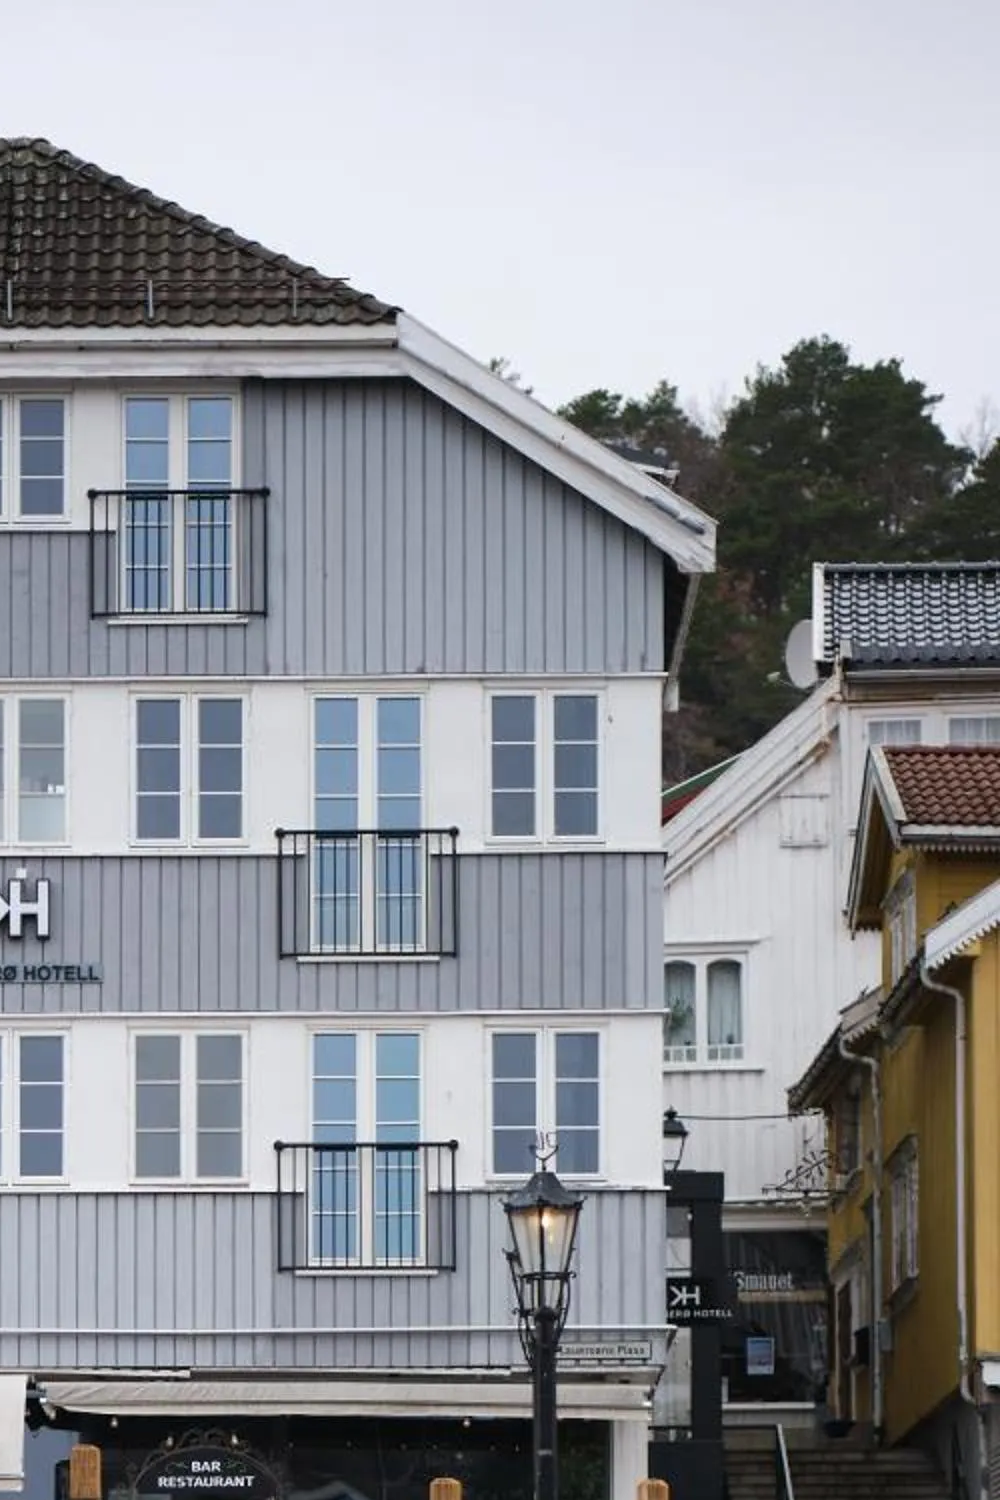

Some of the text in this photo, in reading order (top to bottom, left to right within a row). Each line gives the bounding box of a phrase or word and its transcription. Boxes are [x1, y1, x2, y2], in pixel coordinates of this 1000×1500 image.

[23, 965, 99, 981] HOTELL
[693, 1309, 733, 1318] HOTELL
[191, 1461, 222, 1473] BAR
[157, 1475, 255, 1488] RESTAURANT
